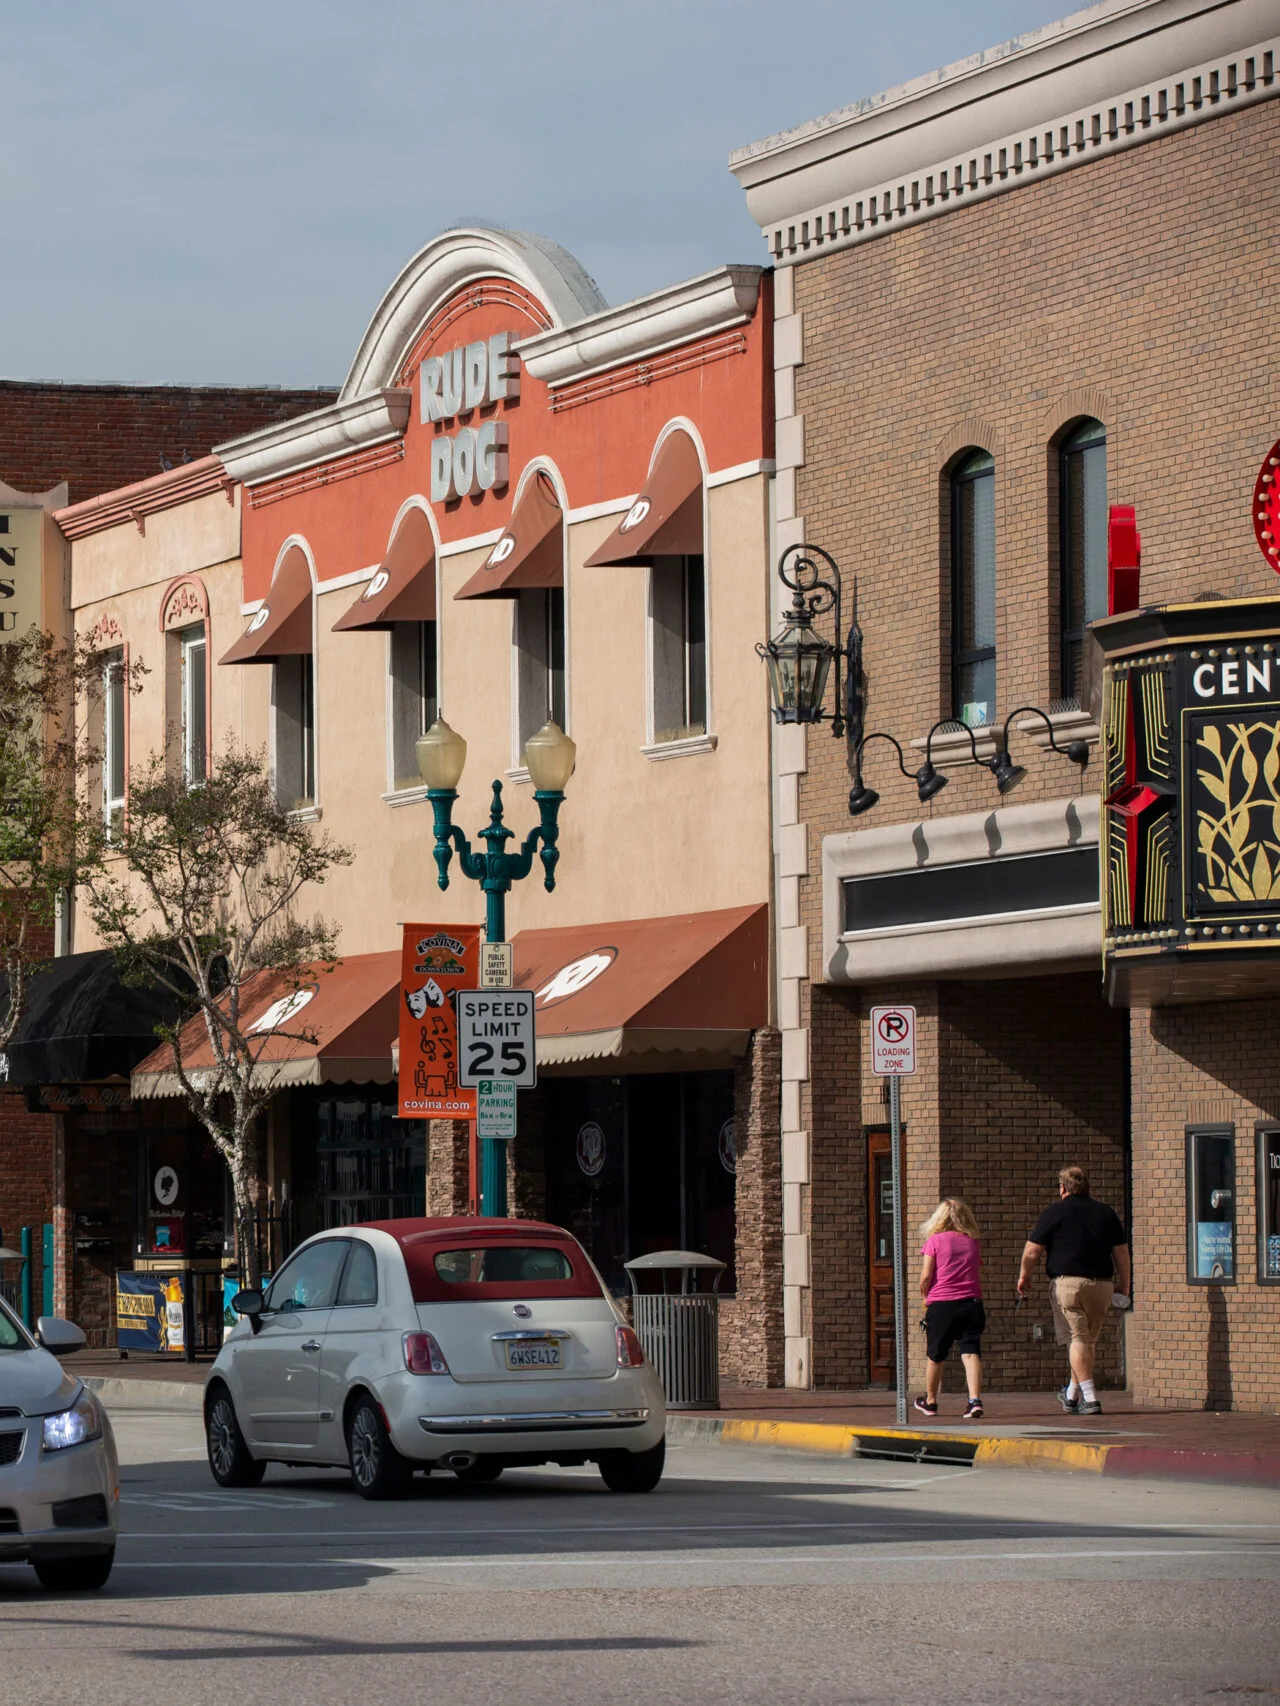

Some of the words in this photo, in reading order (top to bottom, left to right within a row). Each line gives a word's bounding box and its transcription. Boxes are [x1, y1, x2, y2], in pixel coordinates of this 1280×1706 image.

[420, 331, 520, 424] RUDE
[431, 420, 509, 503] DOG
[1193, 658, 1280, 698] CEN
[423, 936, 461, 952] COVINA
[487, 953, 505, 961] PUBLIC
[418, 966, 461, 974] DOWNTOWN
[495, 977, 504, 985] USE
[464, 1002, 528, 1017] SPEED
[472, 1022, 521, 1037] LIMIT
[877, 1047, 911, 1056] LOADING
[467, 1041, 526, 1077] 25
[884, 1059, 904, 1068] ZONE
[481, 1082, 489, 1094] 2
[493, 1083, 513, 1093] HOUR
[404, 1100, 470, 1110] covina.com
[480, 1098, 514, 1108] PARKING
[511, 1349, 559, 1365] 6WSE412
